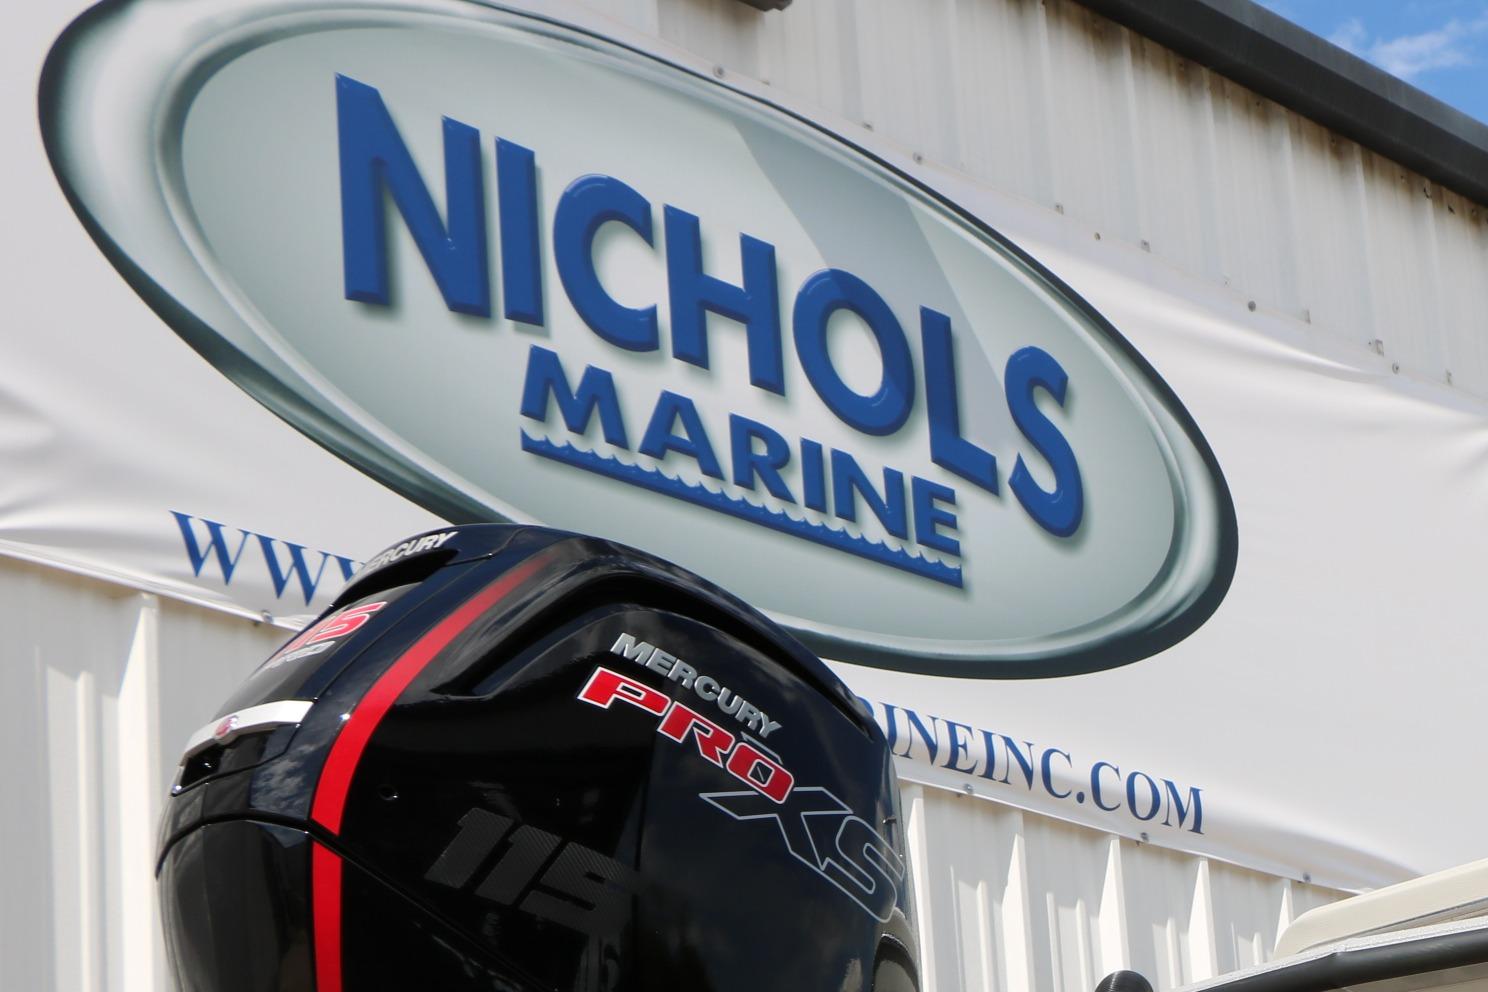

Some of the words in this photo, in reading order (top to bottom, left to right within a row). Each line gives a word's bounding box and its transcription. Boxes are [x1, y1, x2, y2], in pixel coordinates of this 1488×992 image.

[333, 71, 1085, 539] NICHOLS
[519, 344, 963, 557] MARINE
[609, 632, 783, 739] MERCURY
[423, 807, 634, 932] 115
[576, 665, 796, 805] PRO
[698, 786, 906, 924] XS
